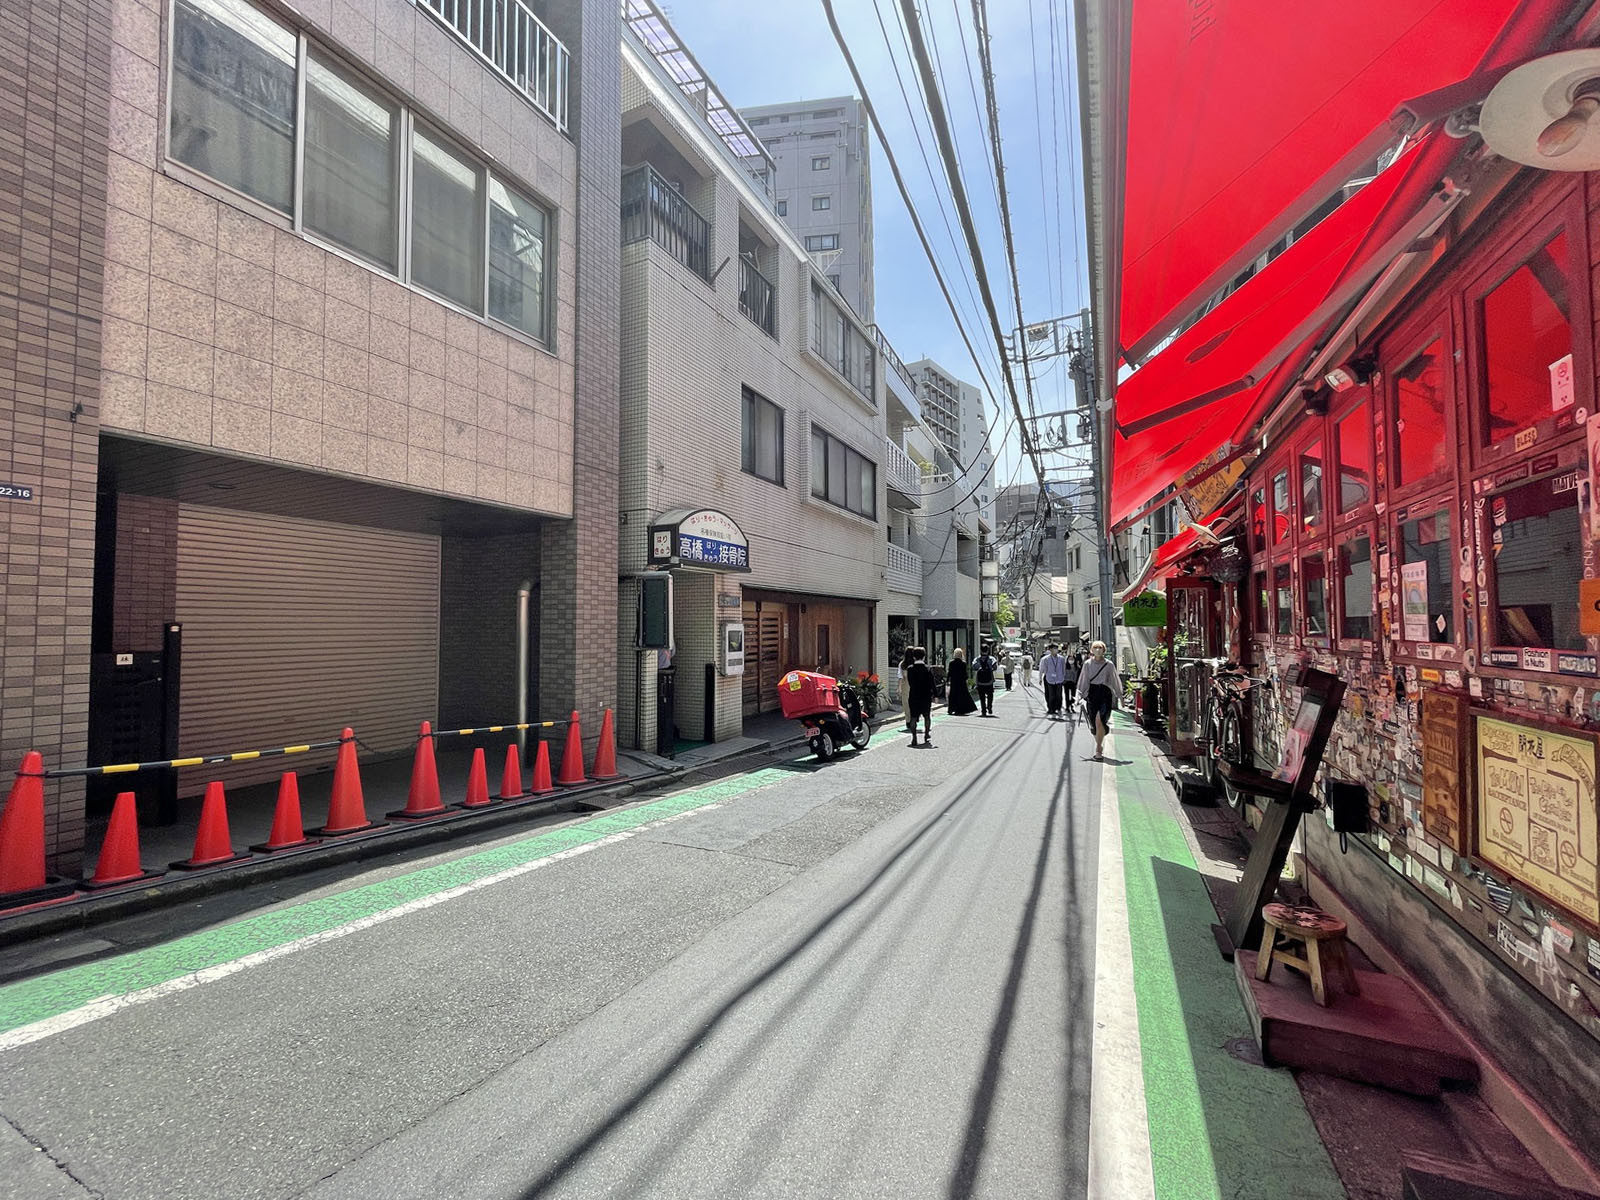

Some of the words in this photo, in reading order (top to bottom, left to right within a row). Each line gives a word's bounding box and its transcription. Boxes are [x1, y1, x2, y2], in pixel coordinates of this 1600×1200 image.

[680, 537, 703, 560] 高橋
[719, 545, 747, 566] 接骨院
